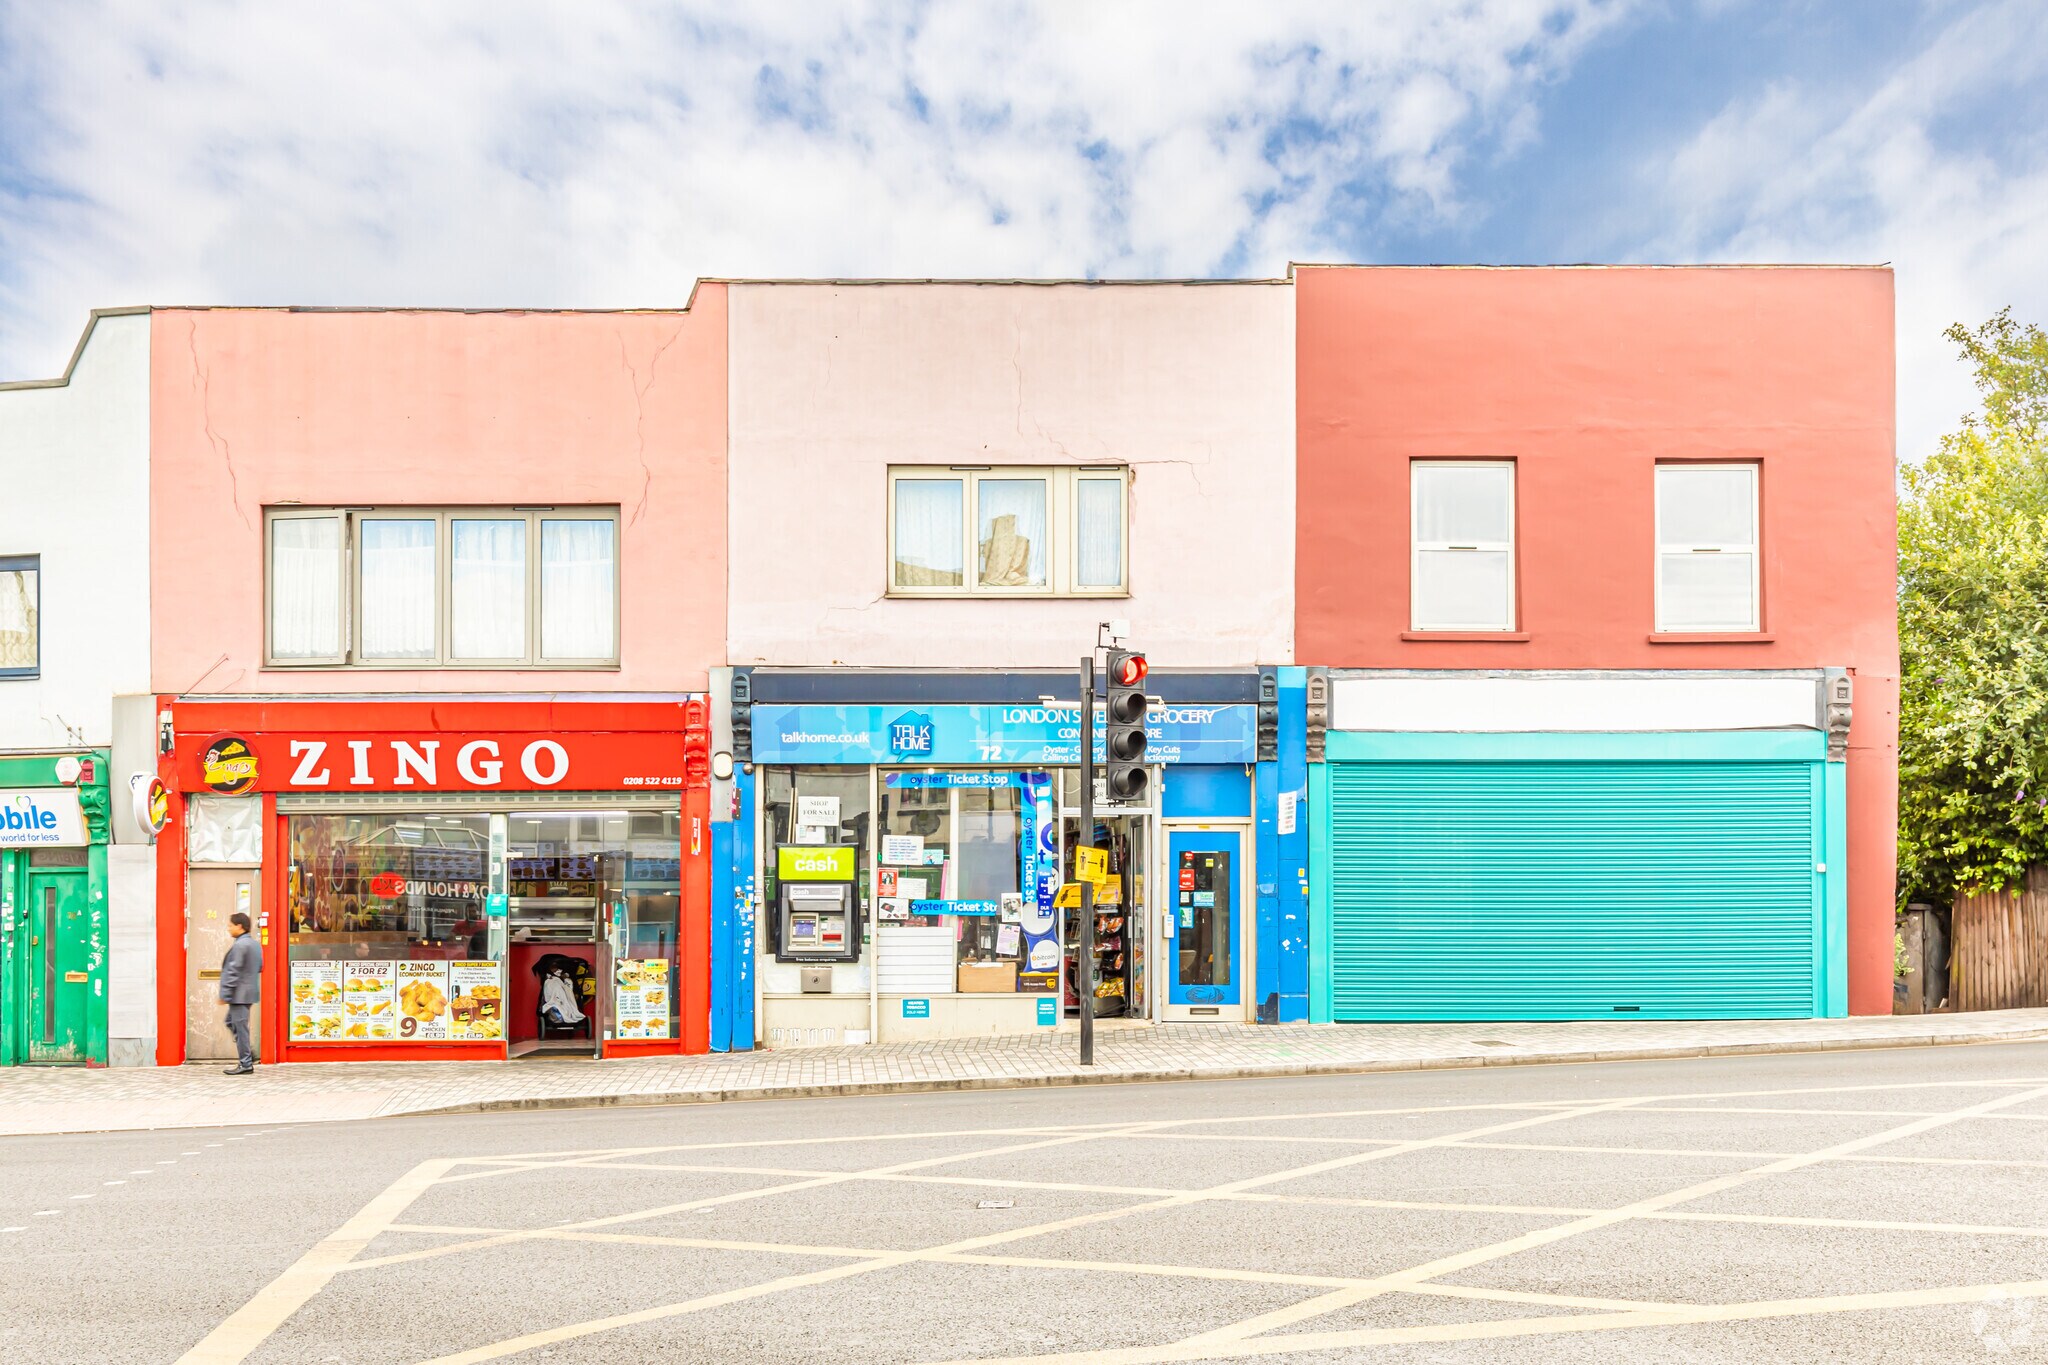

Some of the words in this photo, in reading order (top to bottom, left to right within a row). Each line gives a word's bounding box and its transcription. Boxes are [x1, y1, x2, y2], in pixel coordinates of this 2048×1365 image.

[1003, 709, 1070, 723] LONDON
[1146, 709, 1216, 724] GROCERY
[781, 731, 870, 744] talkhome.co.uk
[893, 724, 930, 738] TALK
[893, 737, 931, 751] HOME
[1043, 745, 1069, 755] Oyster
[979, 746, 1002, 761] 72
[1147, 746, 1162, 756] Key
[1163, 746, 1181, 754] Cuts
[289, 740, 570, 786] ZINGO
[1042, 754, 1069, 764] Calling
[623, 777, 643, 785] 0208
[644, 777, 660, 785] 522
[661, 777, 682, 785] 4119
[910, 775, 943, 786] oyster
[946, 774, 981, 784] Ticket
[982, 774, 1008, 786] Stop
[1, 834, 26, 842] world
[27, 833, 39, 841] for
[41, 832, 60, 841] less
[1023, 818, 1033, 850] oyster
[794, 856, 839, 872] cash
[1024, 854, 1035, 887] Ticket
[911, 902, 943, 913] oyster
[946, 901, 981, 912] Ticket
[206, 909, 217, 919] 74
[358, 967, 375, 975] FOR
[377, 967, 388, 975] £2
[409, 963, 436, 971] ZINGO
[400, 1017, 417, 1038] 9
